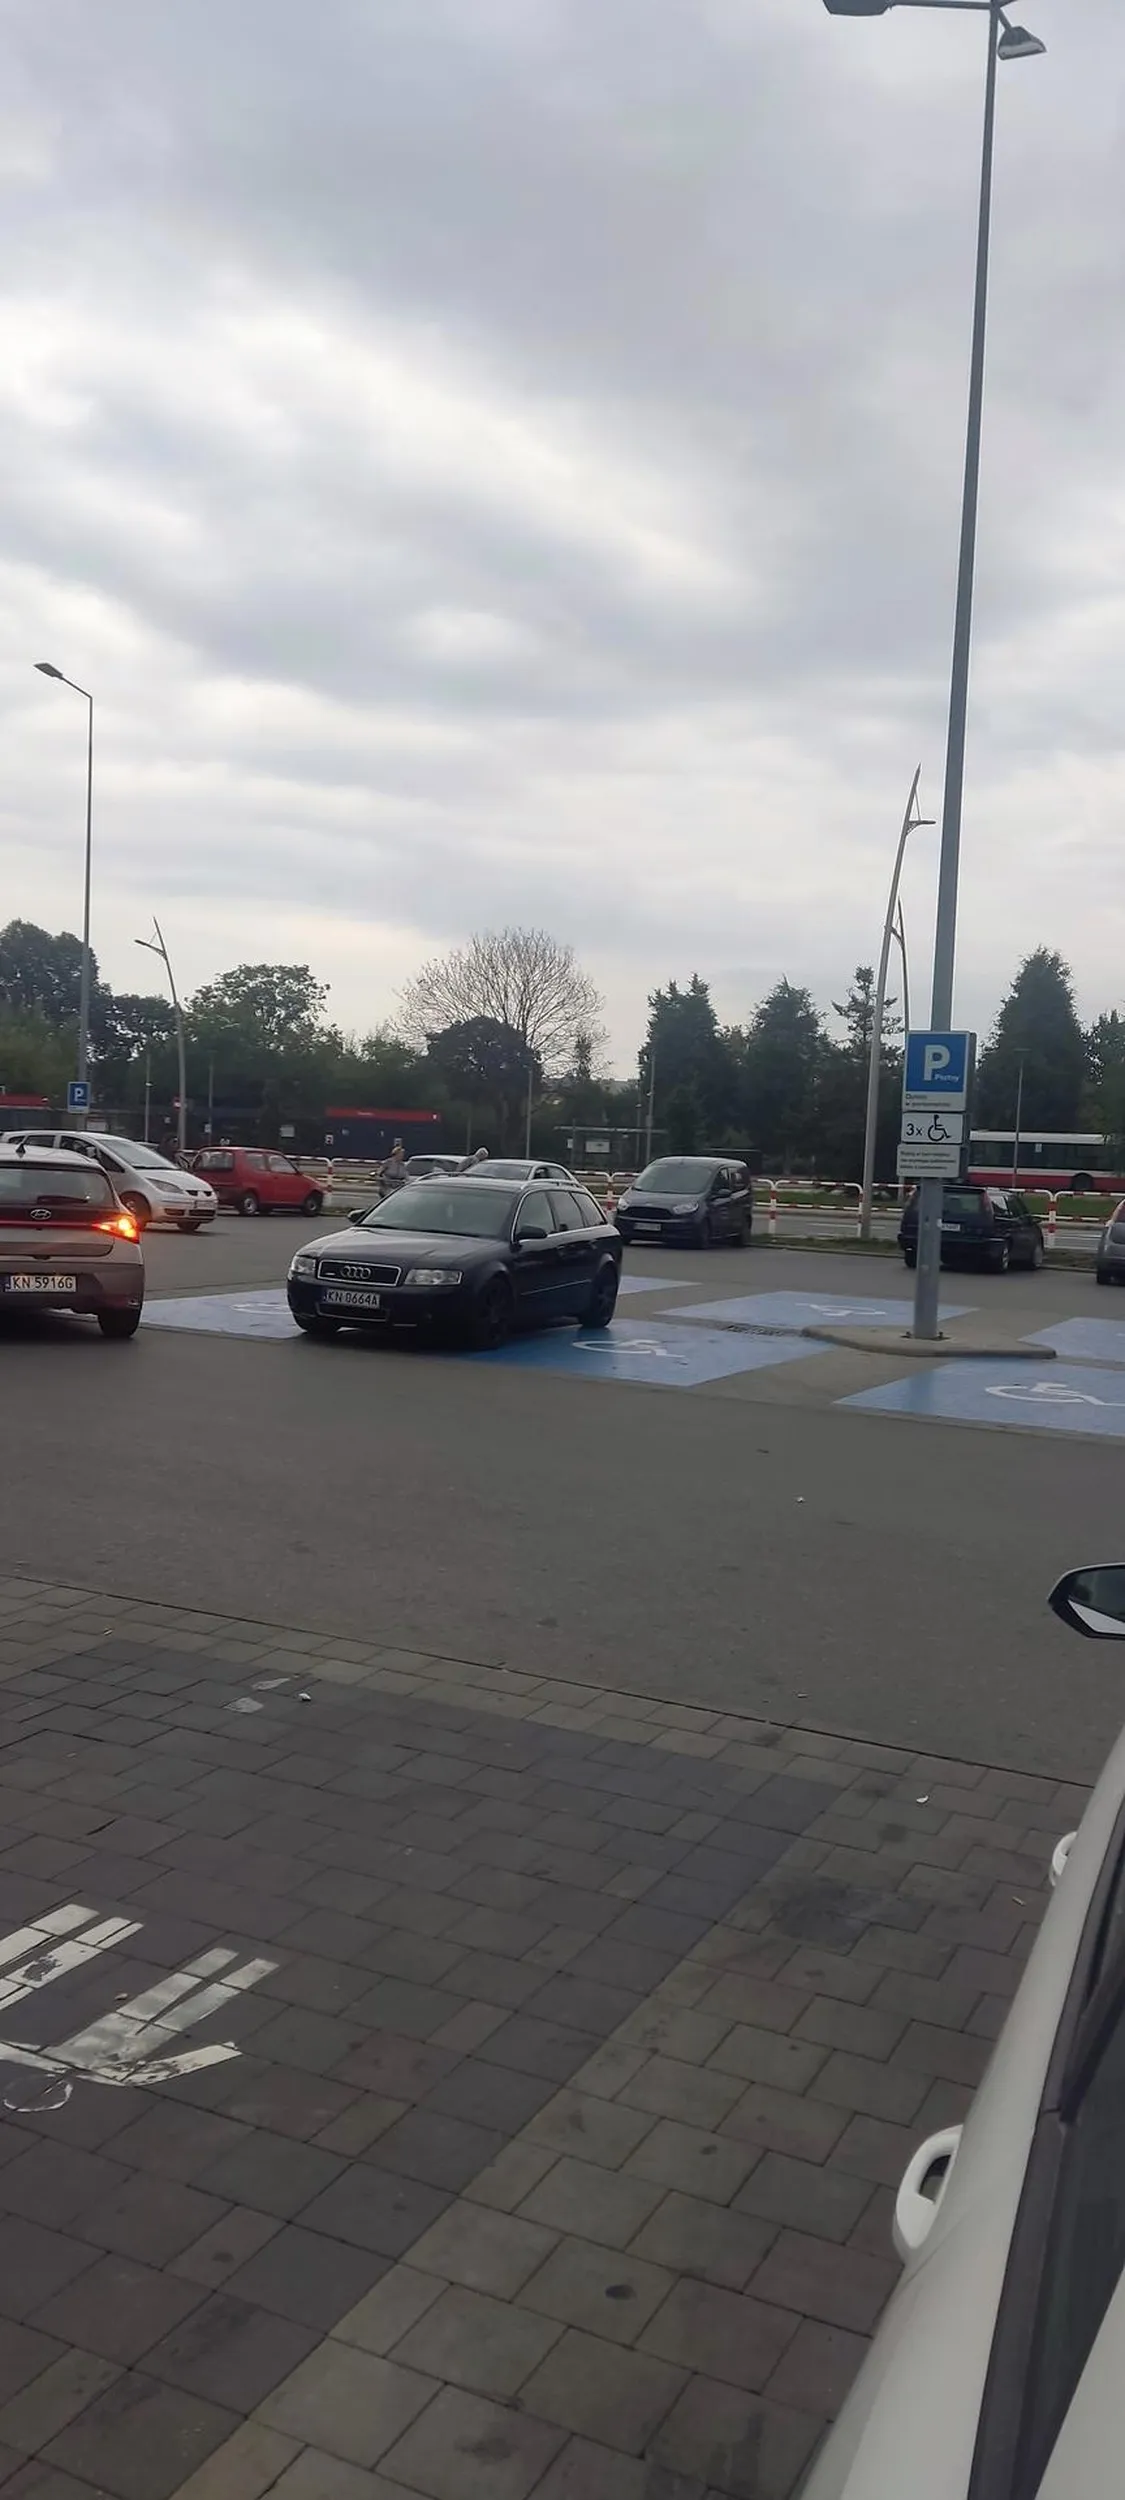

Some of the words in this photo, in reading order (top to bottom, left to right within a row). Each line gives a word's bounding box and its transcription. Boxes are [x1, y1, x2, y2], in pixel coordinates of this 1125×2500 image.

[924, 1045, 950, 1081] P
[74, 1087, 85, 1102] P
[12, 1276, 31, 1289] KN
[34, 1276, 73, 1289] 5916G
[328, 1291, 343, 1303] KN
